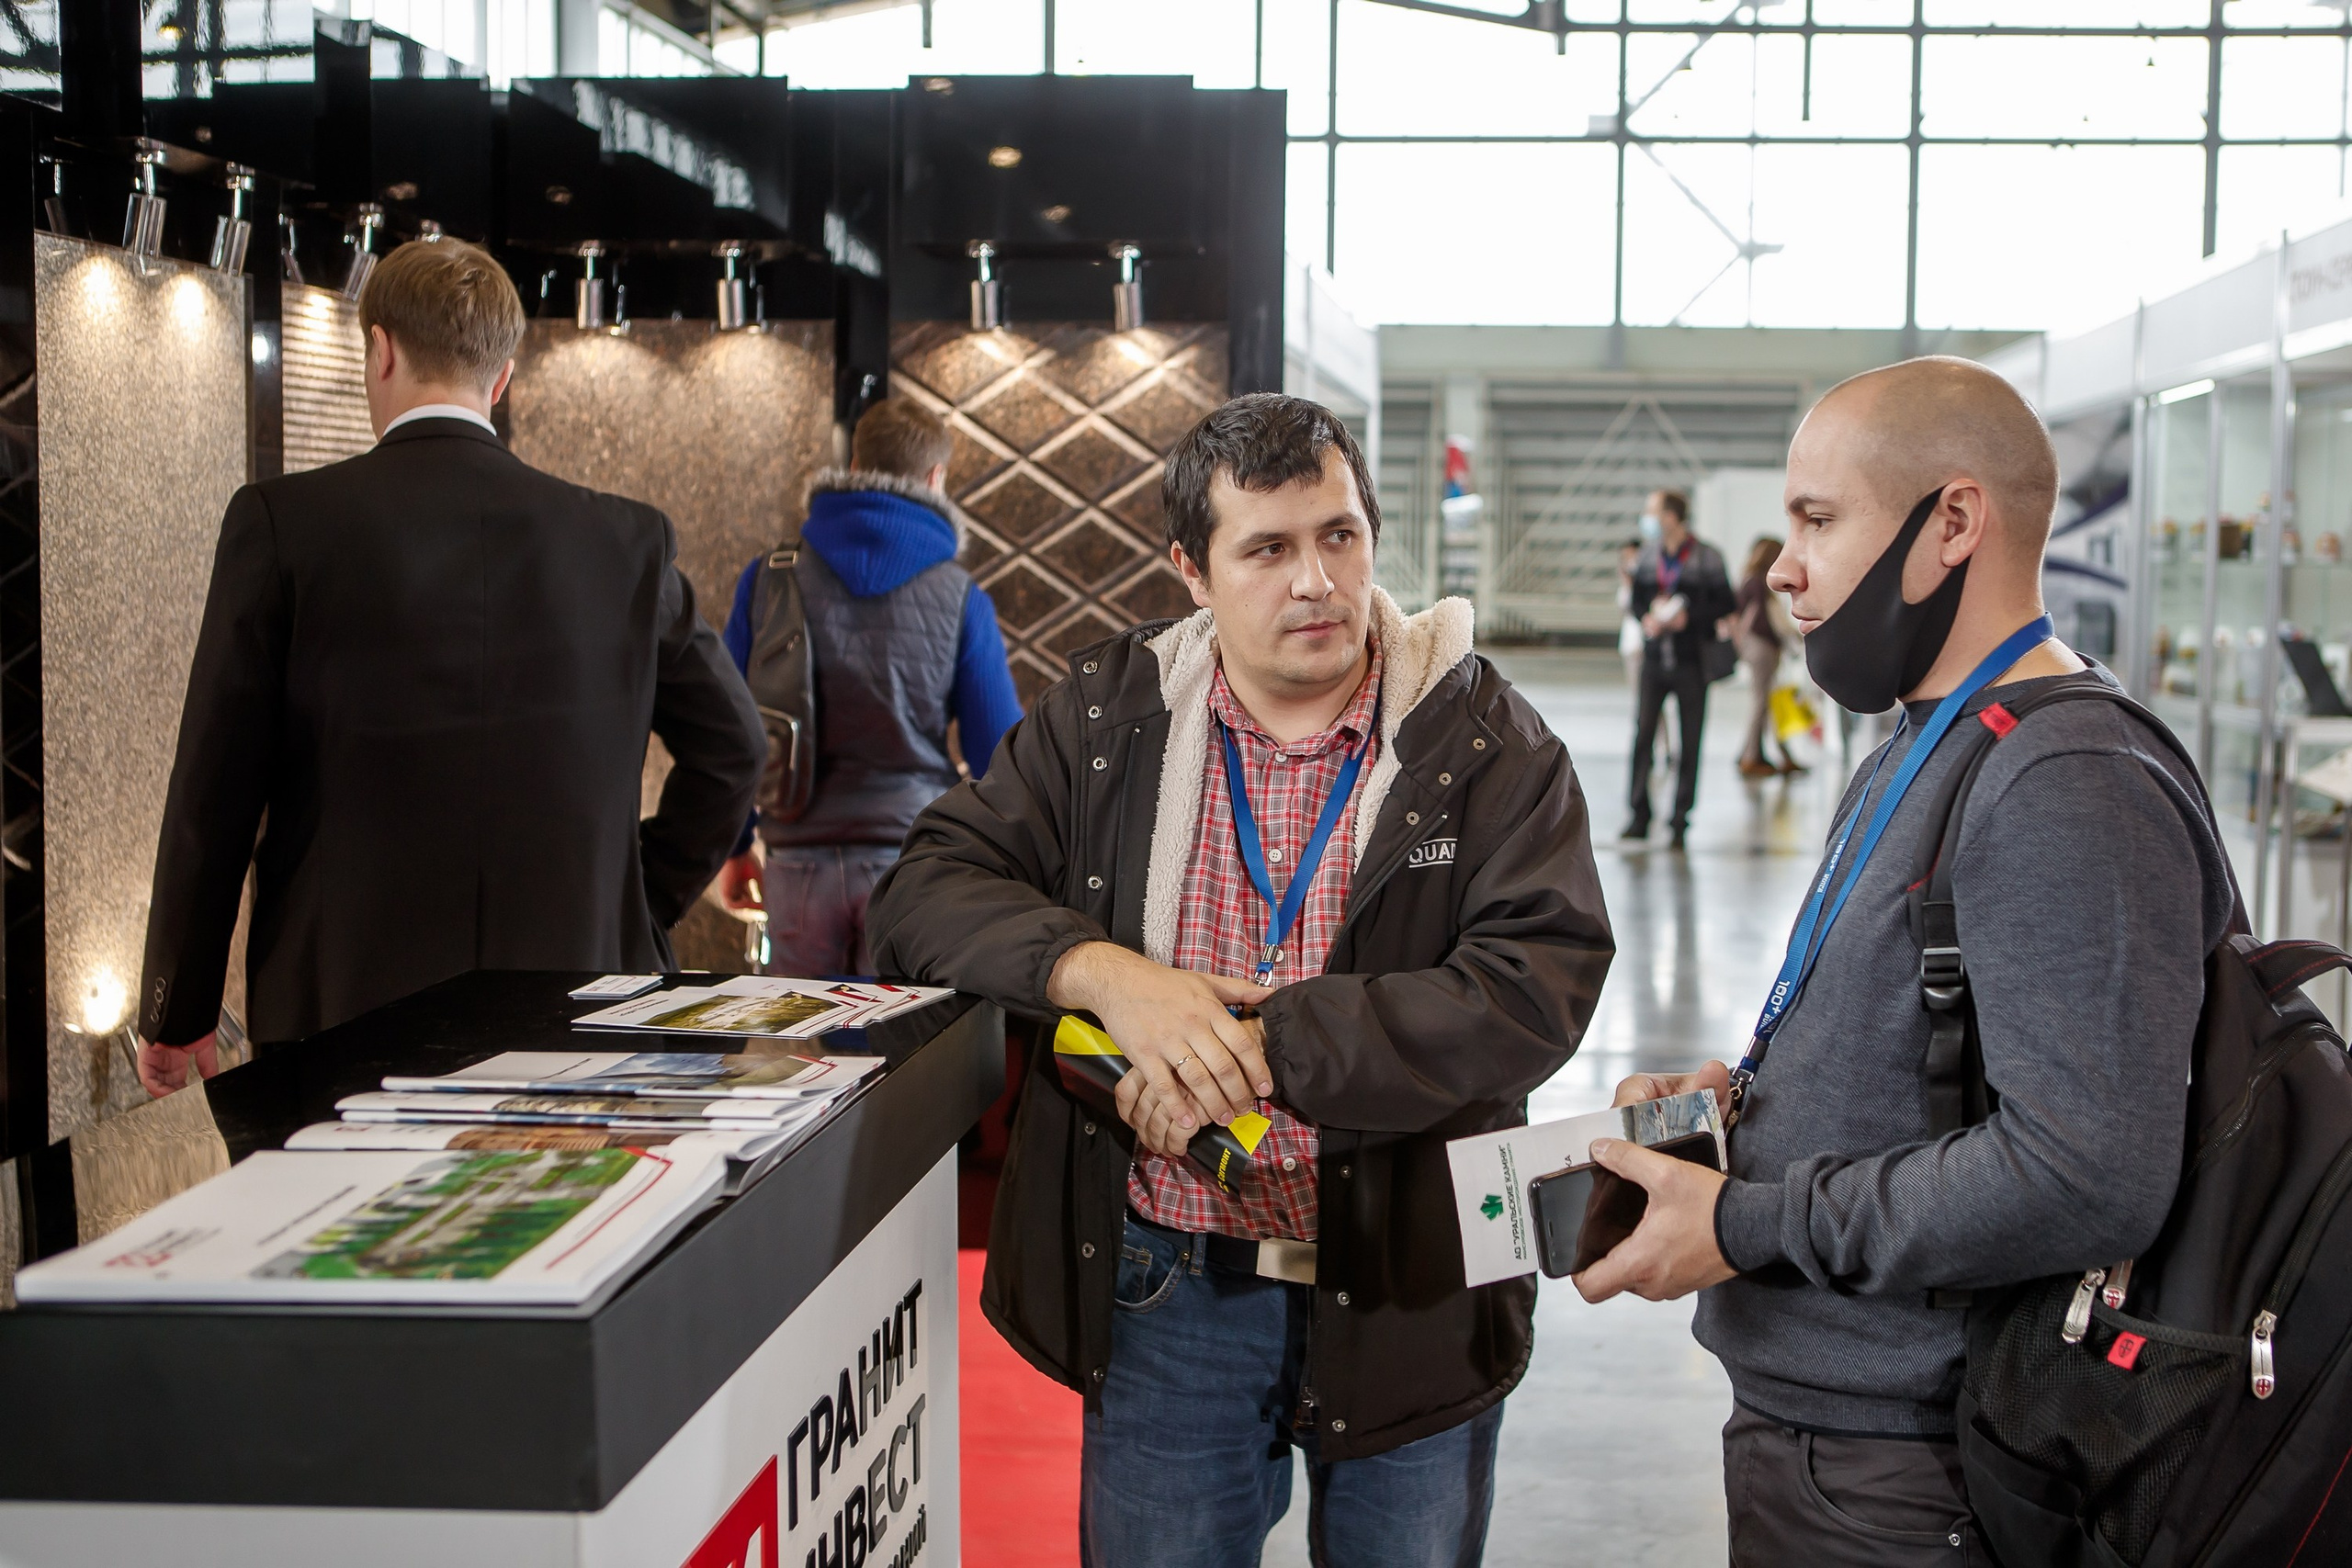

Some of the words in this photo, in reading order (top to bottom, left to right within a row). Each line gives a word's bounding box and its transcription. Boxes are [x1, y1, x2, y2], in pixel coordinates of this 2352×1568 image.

[1770, 980, 1791, 1015] 100+
[787, 1278, 922, 1532] ГРАНИТ
[805, 1393, 926, 1568] НВЕСТ
